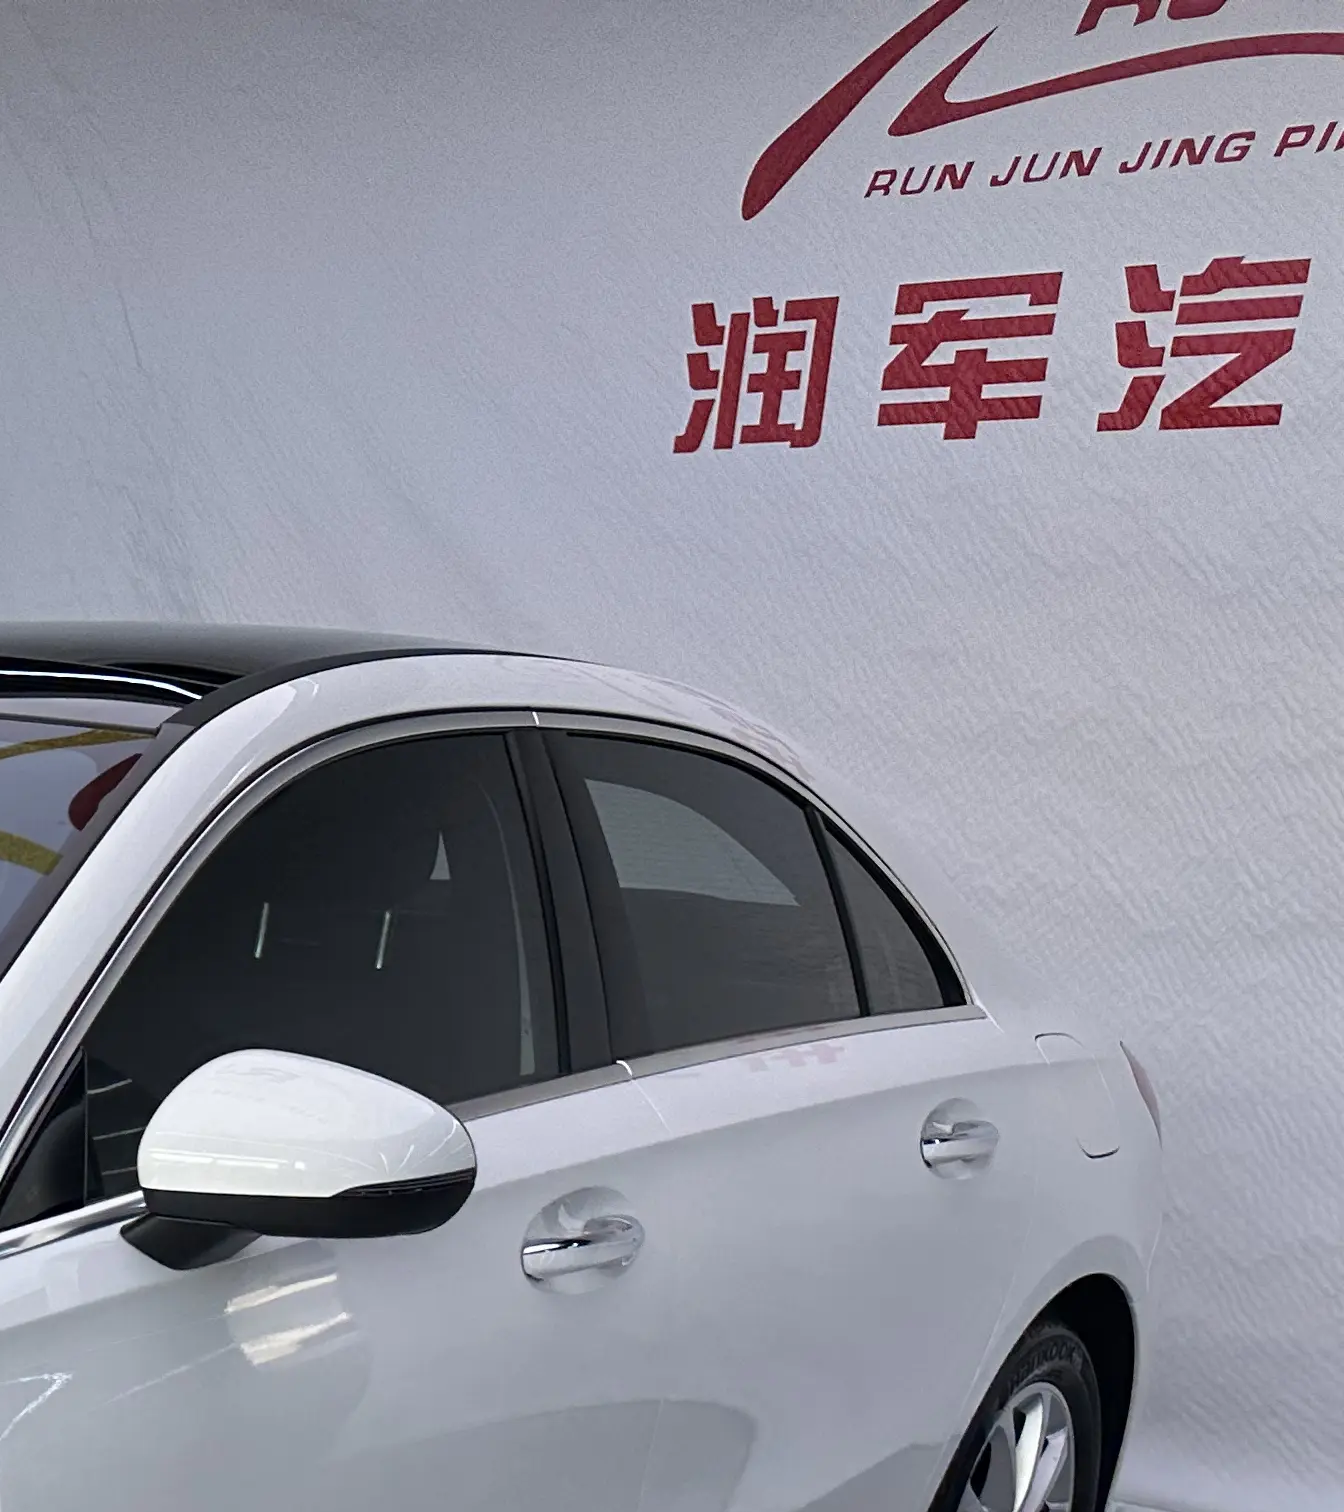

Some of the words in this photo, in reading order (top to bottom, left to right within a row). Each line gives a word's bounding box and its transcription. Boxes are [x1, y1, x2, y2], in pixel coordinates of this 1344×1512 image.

[864, 161, 973, 198] RUN
[989, 147, 1102, 188] JUN
[1118, 131, 1256, 174] JING
[1273, 121, 1344, 157] PI
[673, 256, 1311, 454] 润军汽
